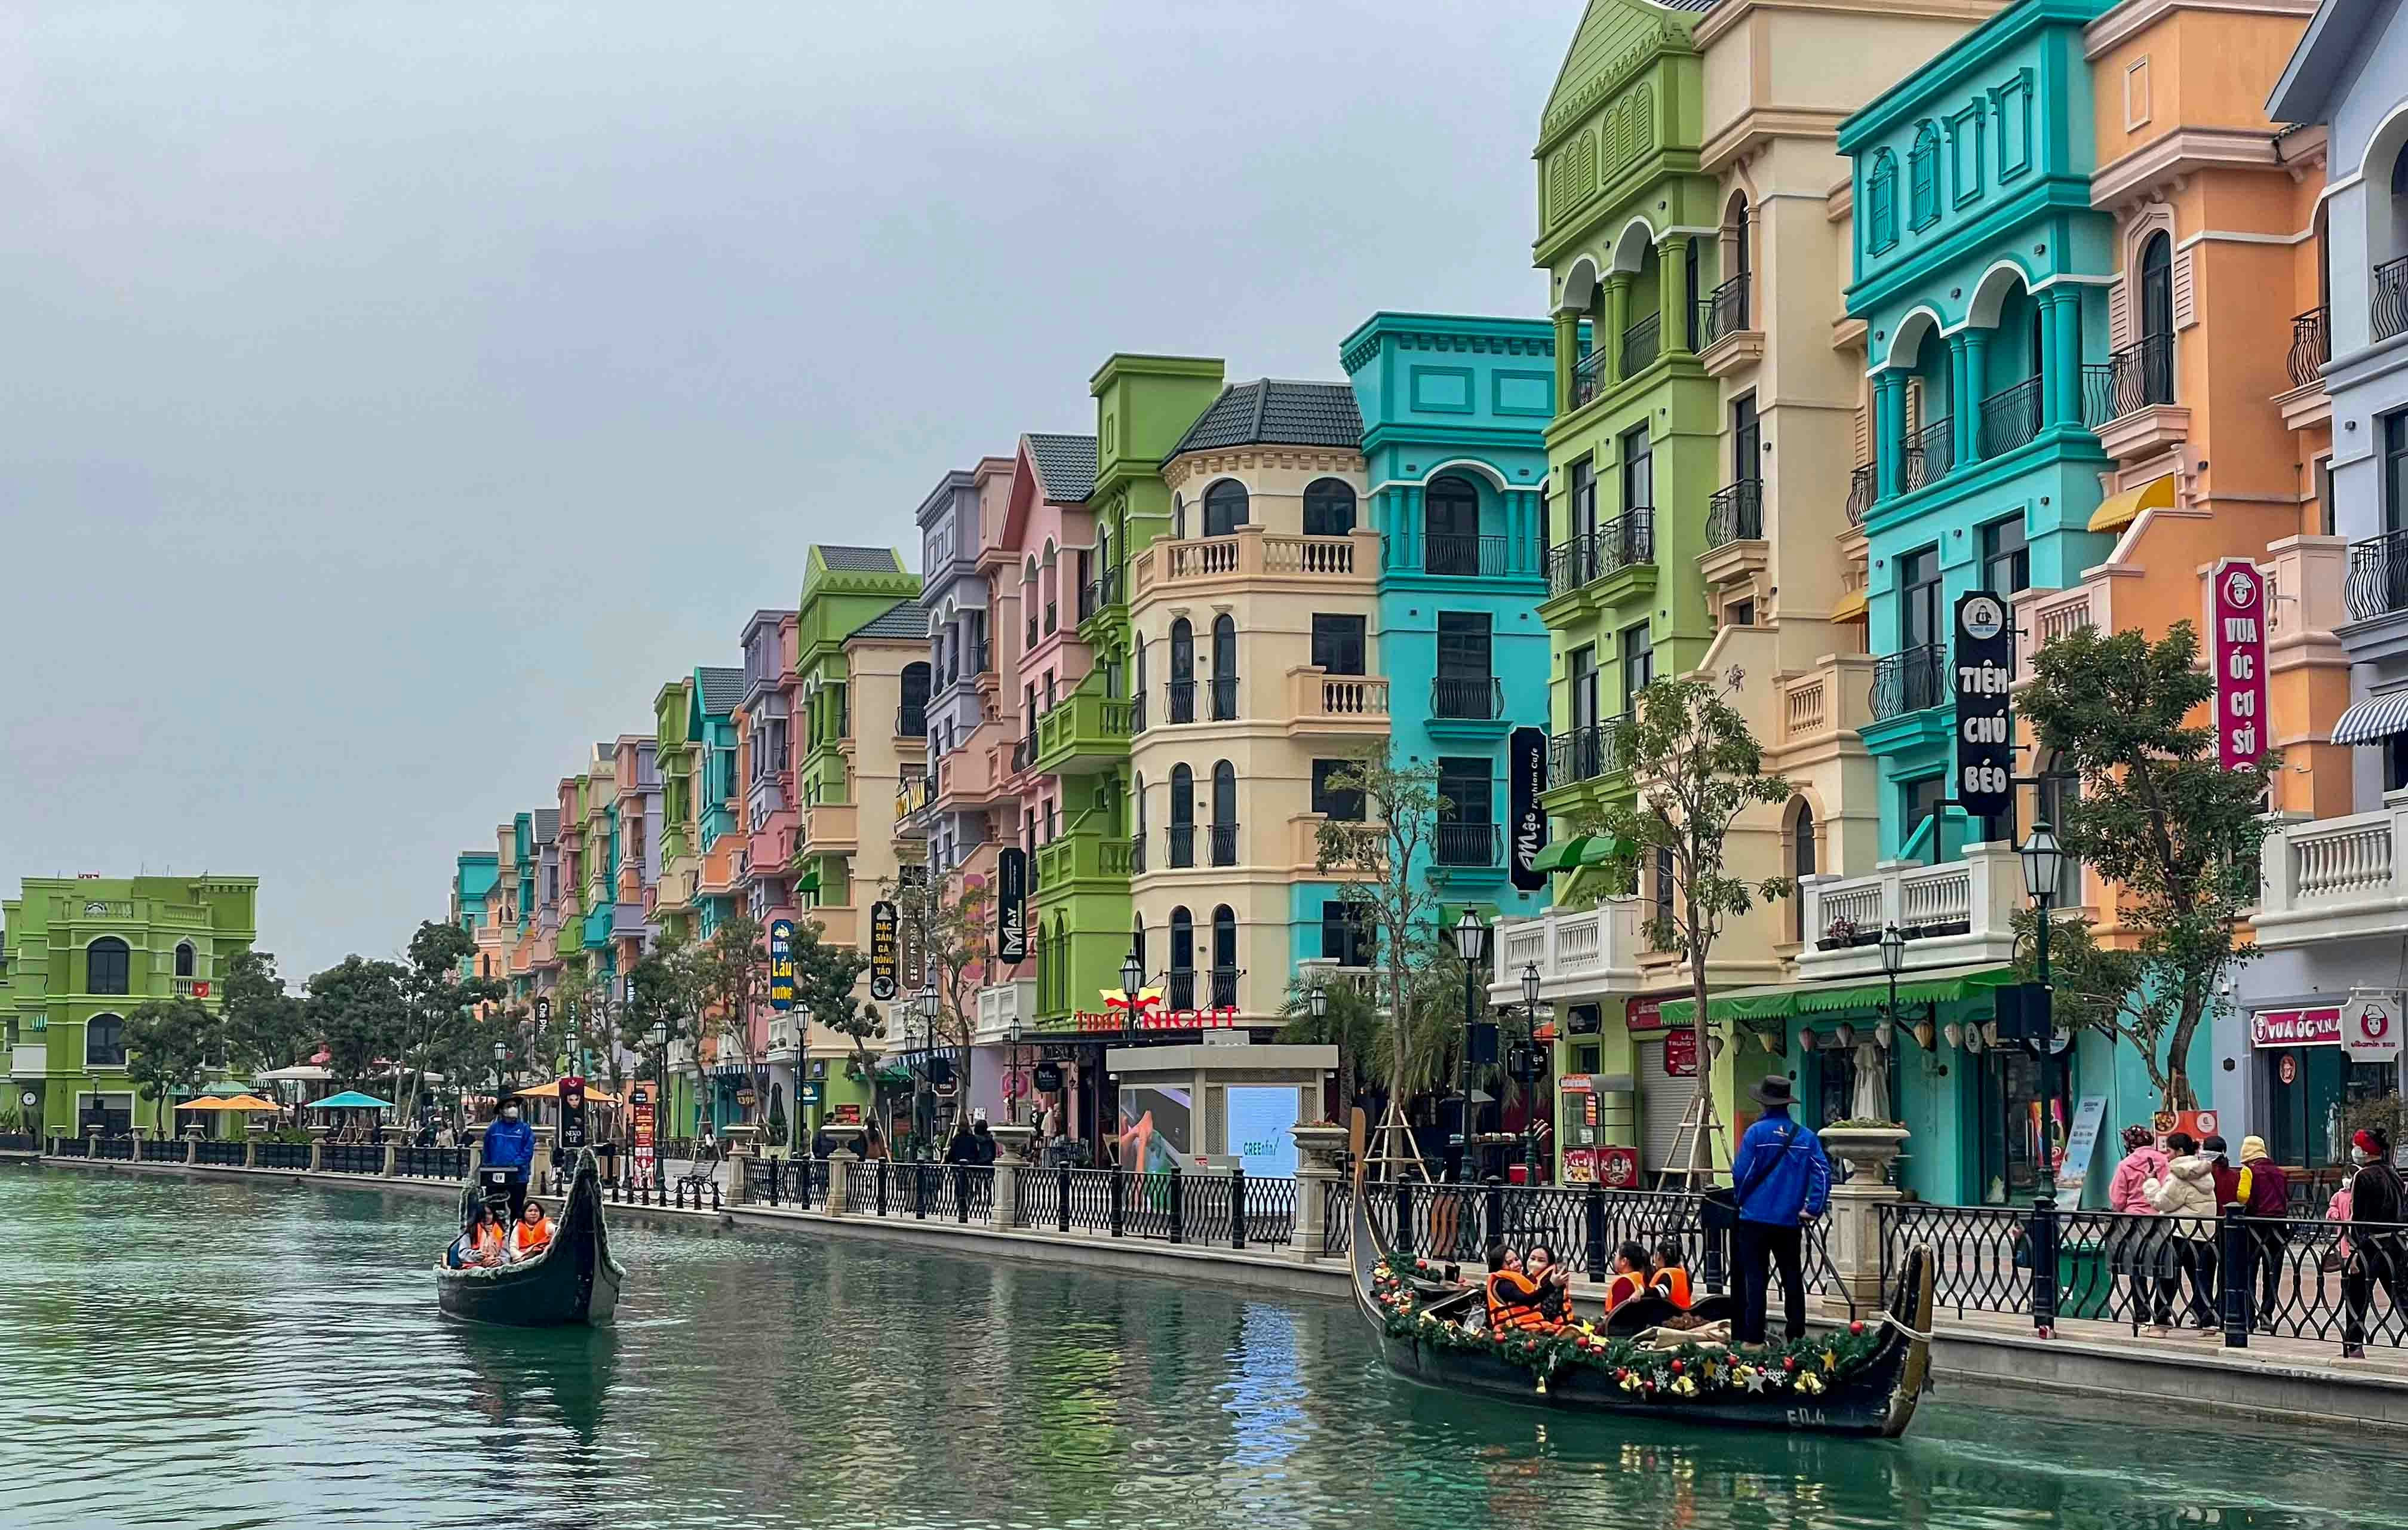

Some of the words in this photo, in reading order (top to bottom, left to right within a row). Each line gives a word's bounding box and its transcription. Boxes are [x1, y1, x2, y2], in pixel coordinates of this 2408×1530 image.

[2225, 617, 2258, 643] VUA
[1959, 659, 2007, 699] TIỆM
[2230, 646, 2253, 680] ỐC
[2231, 689, 2255, 717] CƠ
[1964, 708, 2007, 743] CHÚ
[2232, 721, 2255, 754] SỞ
[1965, 758, 2007, 793] BÉO
[1518, 812, 1541, 871] Mộc
[1142, 1005, 1236, 1029] NIGHT
[2269, 1020, 2294, 1039] VUA
